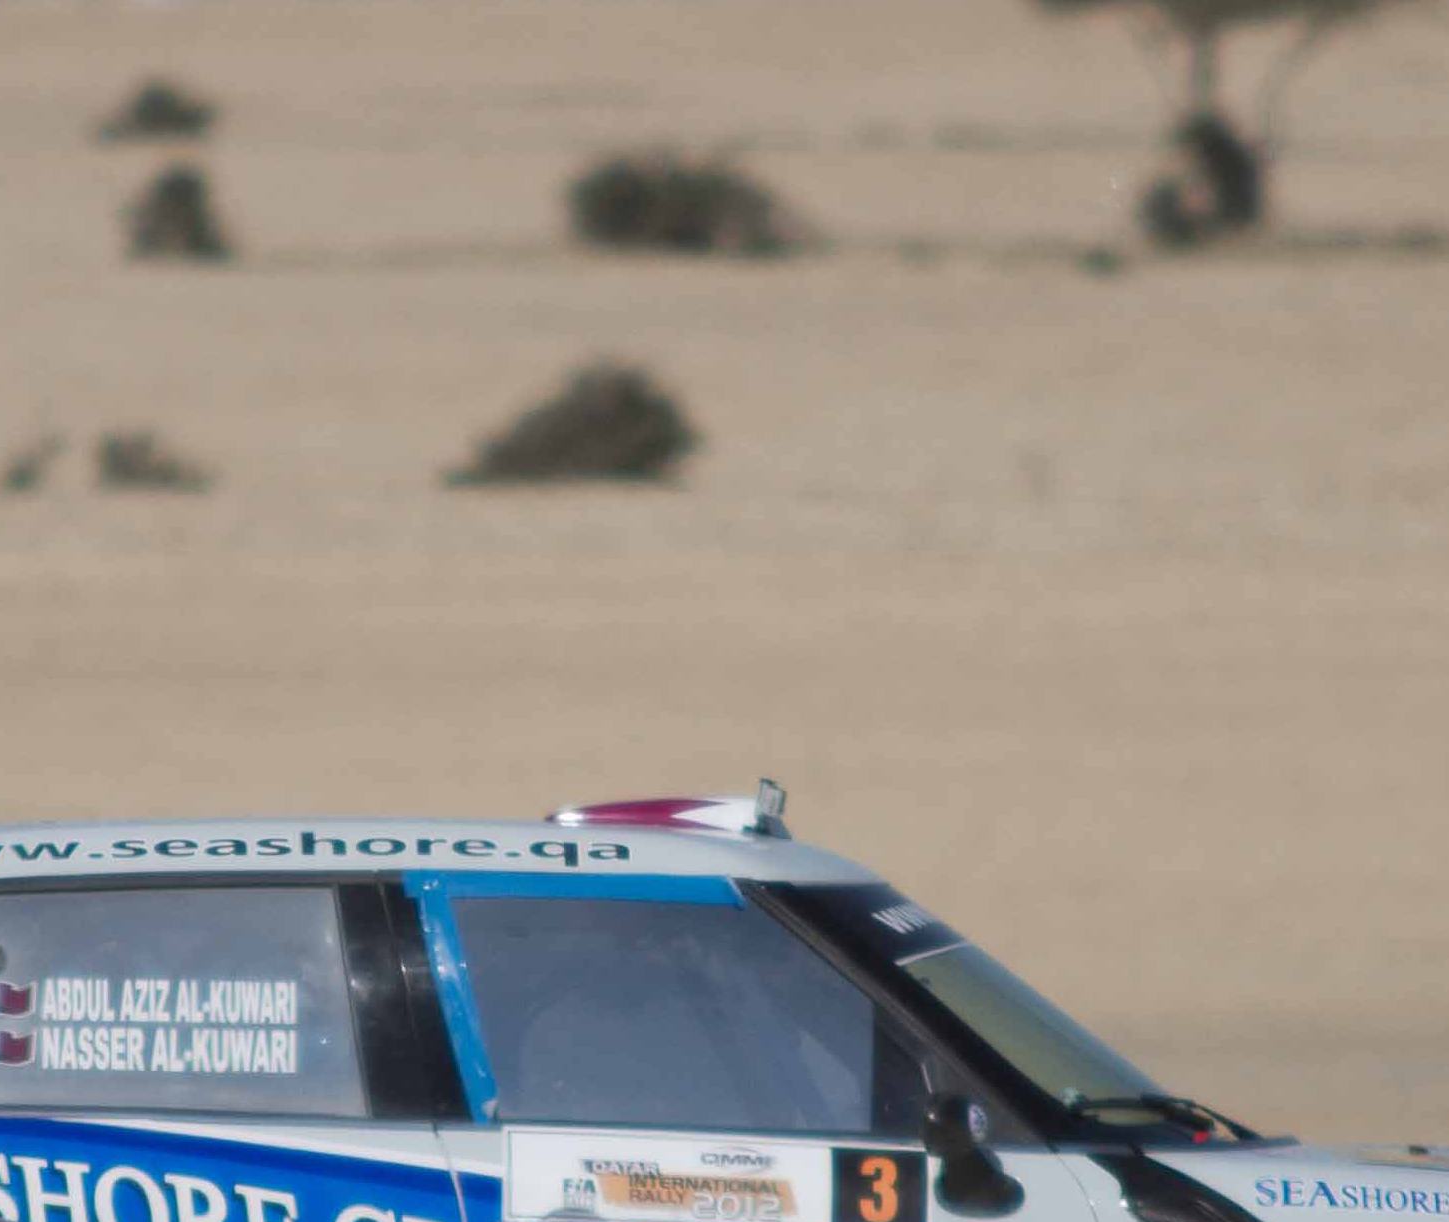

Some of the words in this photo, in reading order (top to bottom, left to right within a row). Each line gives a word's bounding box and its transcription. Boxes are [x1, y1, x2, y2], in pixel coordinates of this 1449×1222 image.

[41, 978, 115, 1021] ABDUL
[120, 979, 171, 1022] AZIZ
[175, 980, 297, 1024] AL-KUWARI
[41, 1027, 145, 1070] NASSER
[151, 1029, 297, 1073] AL-KUWARI
[628, 1173, 779, 1194] INTERNATIONAL
[628, 1189, 687, 1206] RALLY
[693, 1191, 782, 1222] 2012
